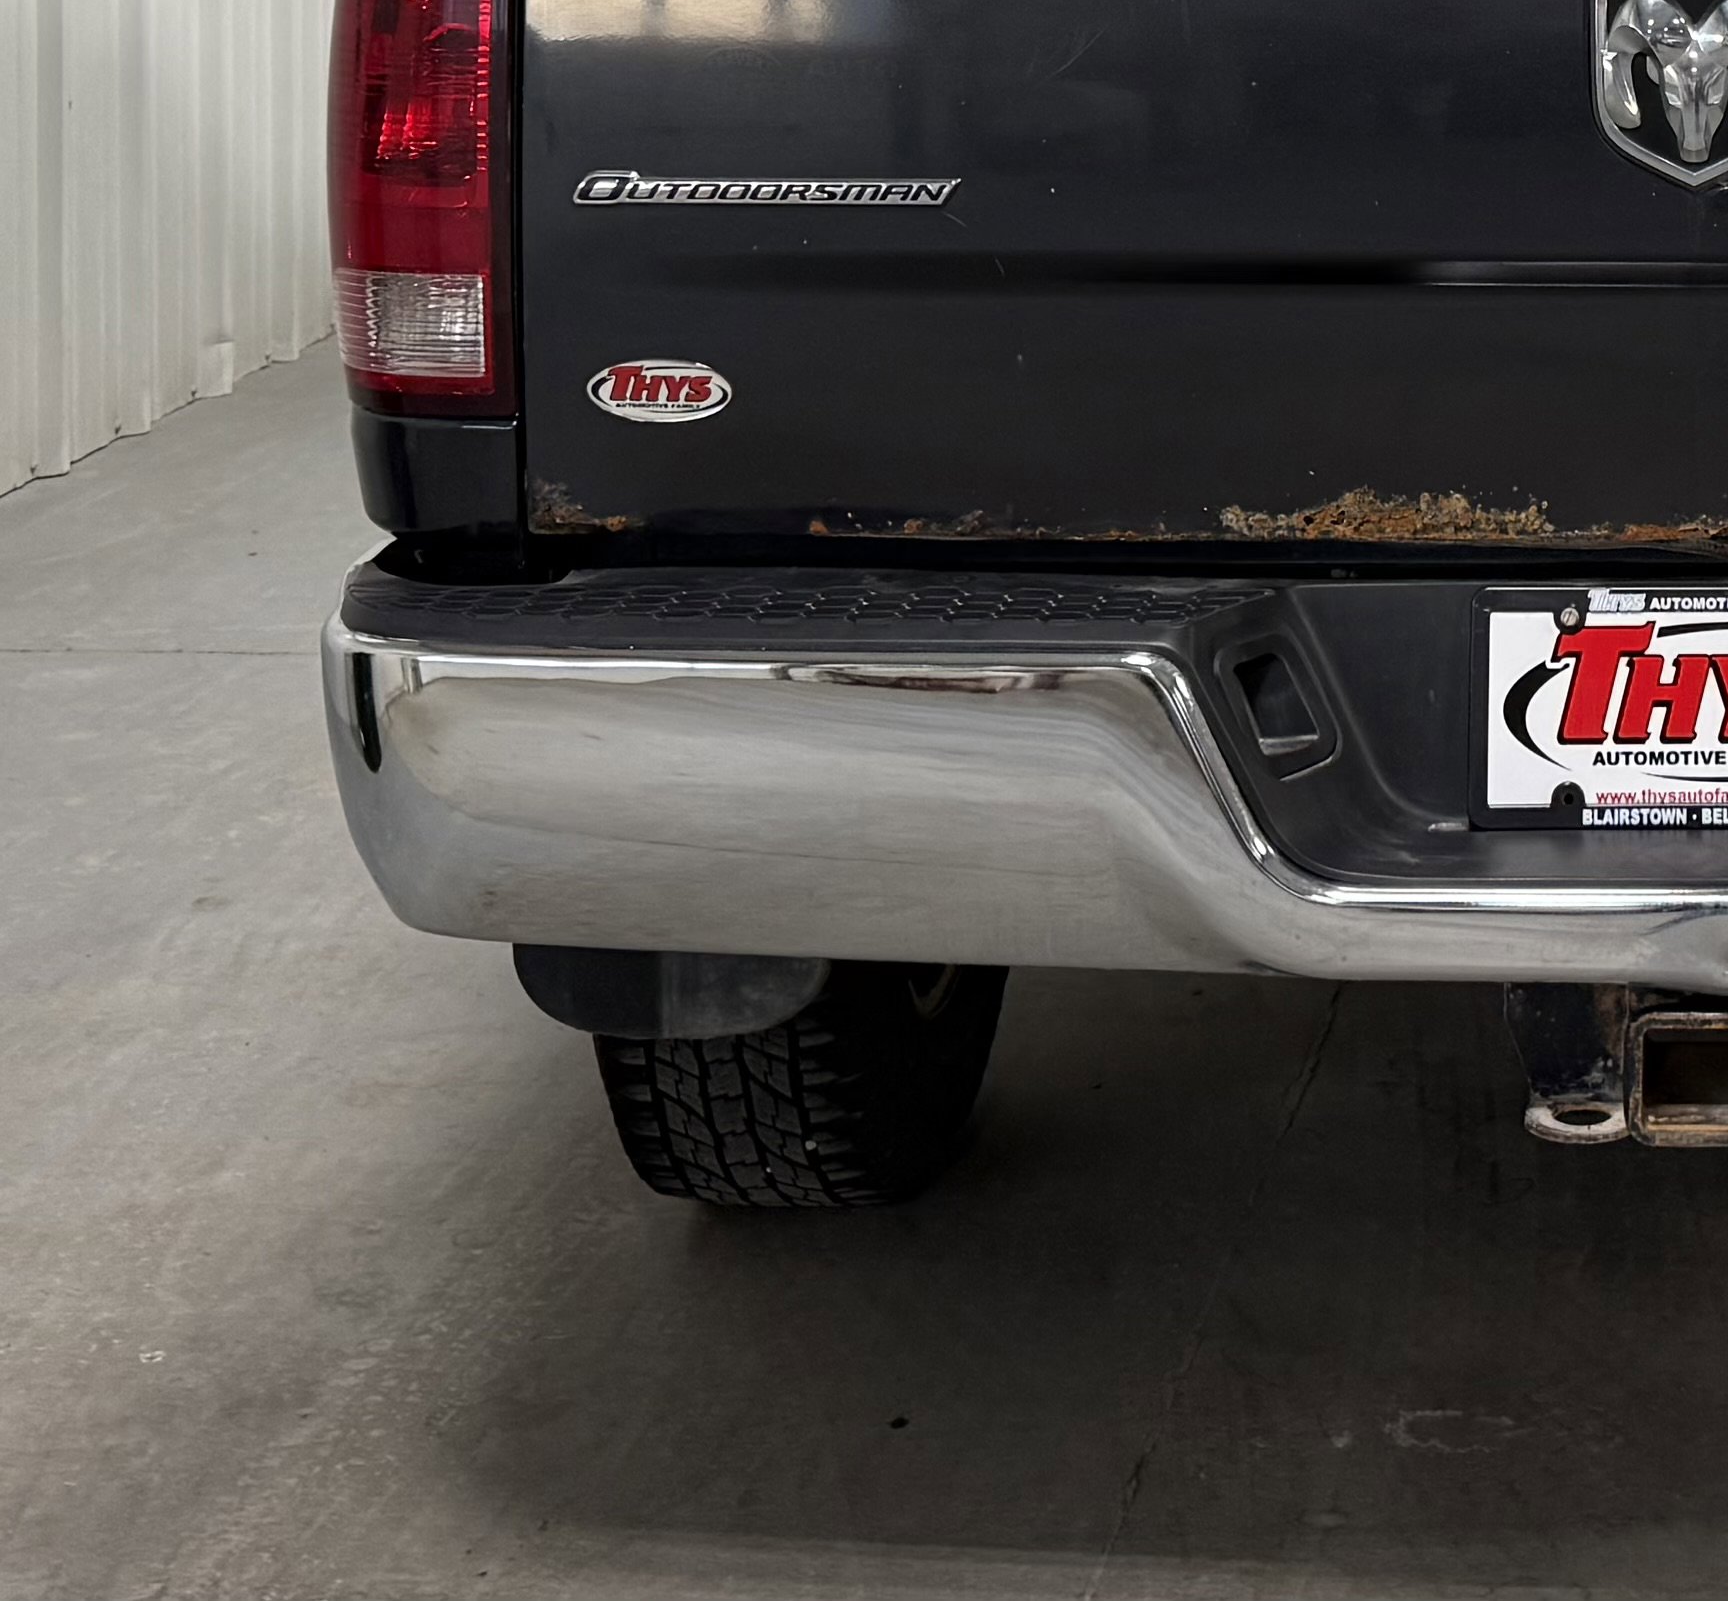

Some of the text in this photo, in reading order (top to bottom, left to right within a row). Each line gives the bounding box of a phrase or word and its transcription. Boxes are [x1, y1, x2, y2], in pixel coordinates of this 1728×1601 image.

[607, 365, 713, 403] THYS
[1592, 750, 1727, 766] AUTOMOTIVE
[1582, 808, 1688, 826] BLAIRSTOWN
